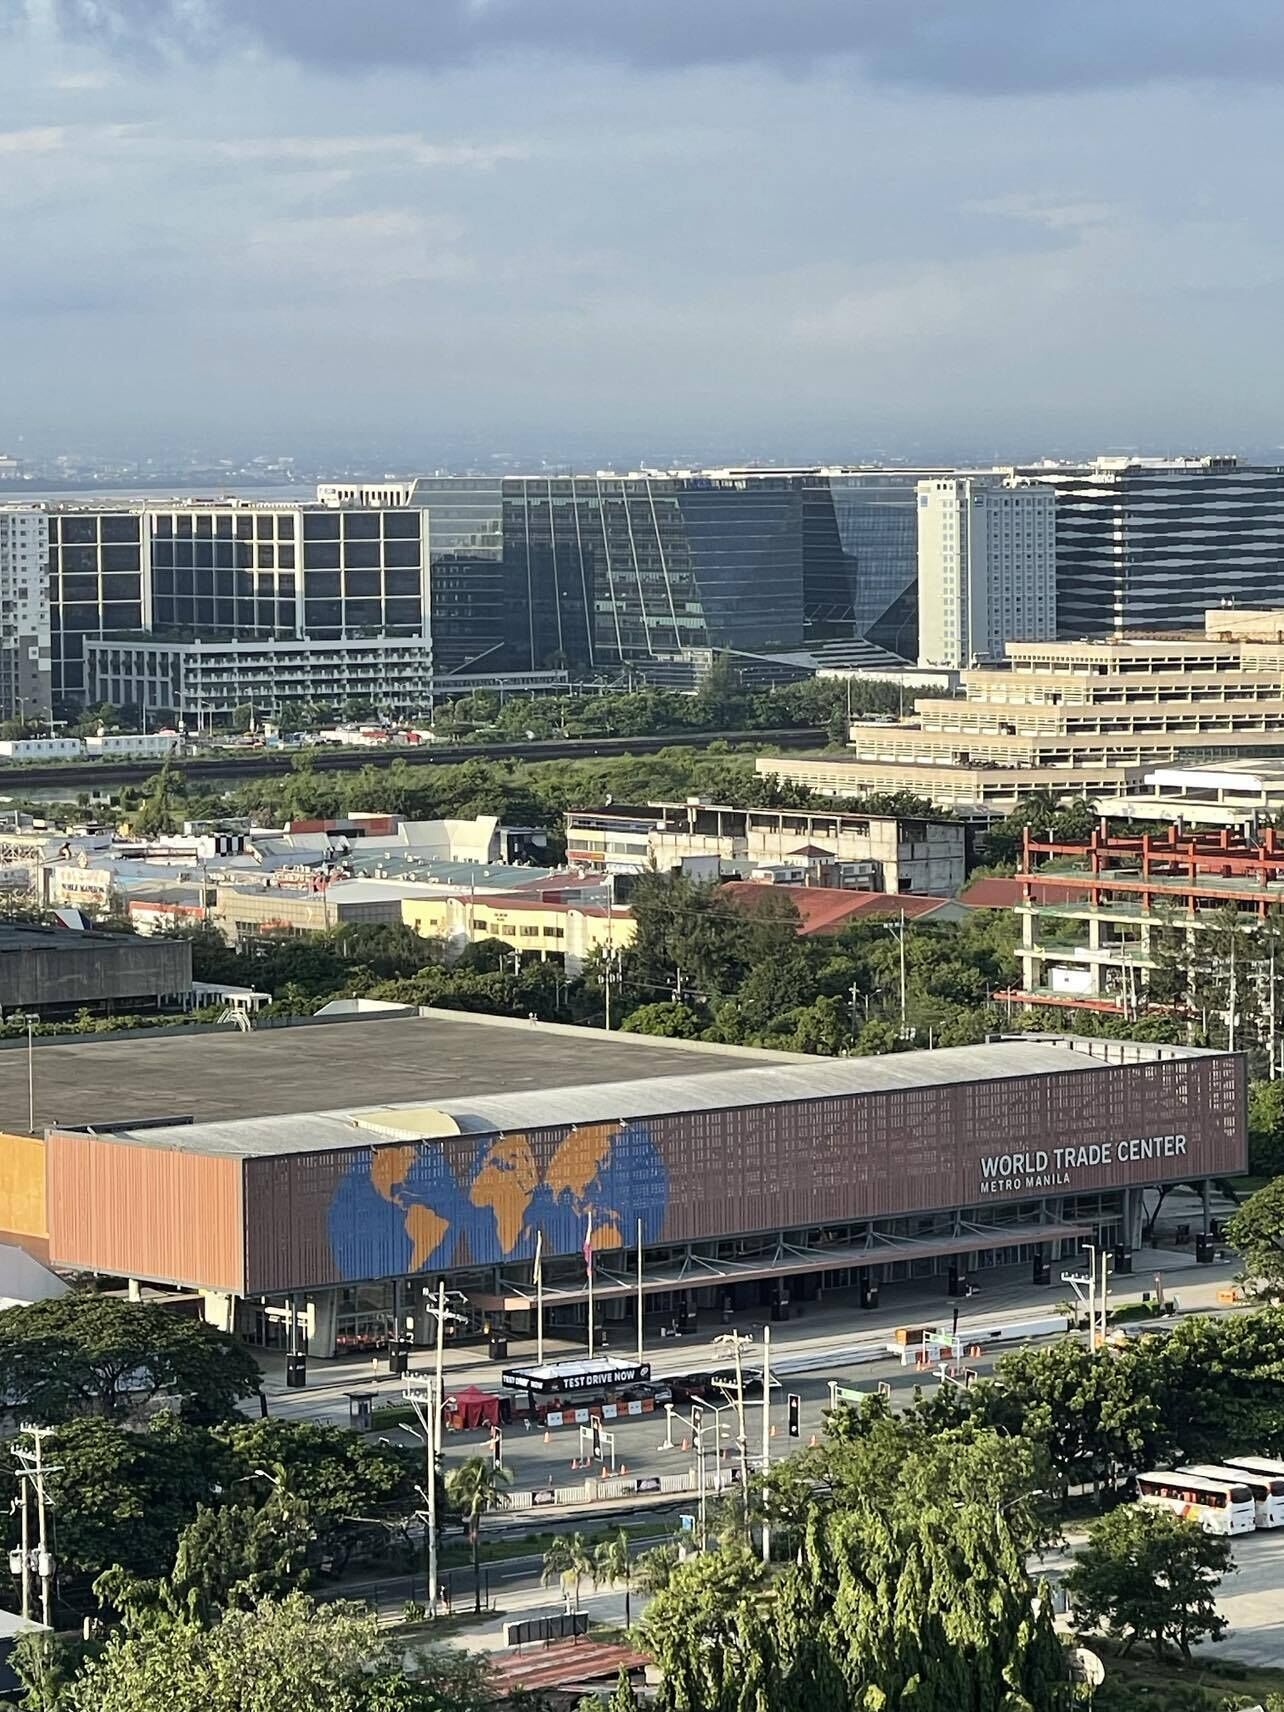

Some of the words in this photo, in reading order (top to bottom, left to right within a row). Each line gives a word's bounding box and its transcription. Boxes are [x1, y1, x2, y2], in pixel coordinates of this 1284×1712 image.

[981, 1152, 1049, 1178] WORLD
[1054, 1143, 1112, 1169] TRADE
[1117, 1134, 1186, 1162] CENTER
[980, 1178, 1021, 1193] METRO
[1025, 1172, 1071, 1187] MANILA
[563, 1377, 585, 1388] TEST
[586, 1373, 613, 1386] DRIVE
[614, 1370, 635, 1381] NOW
